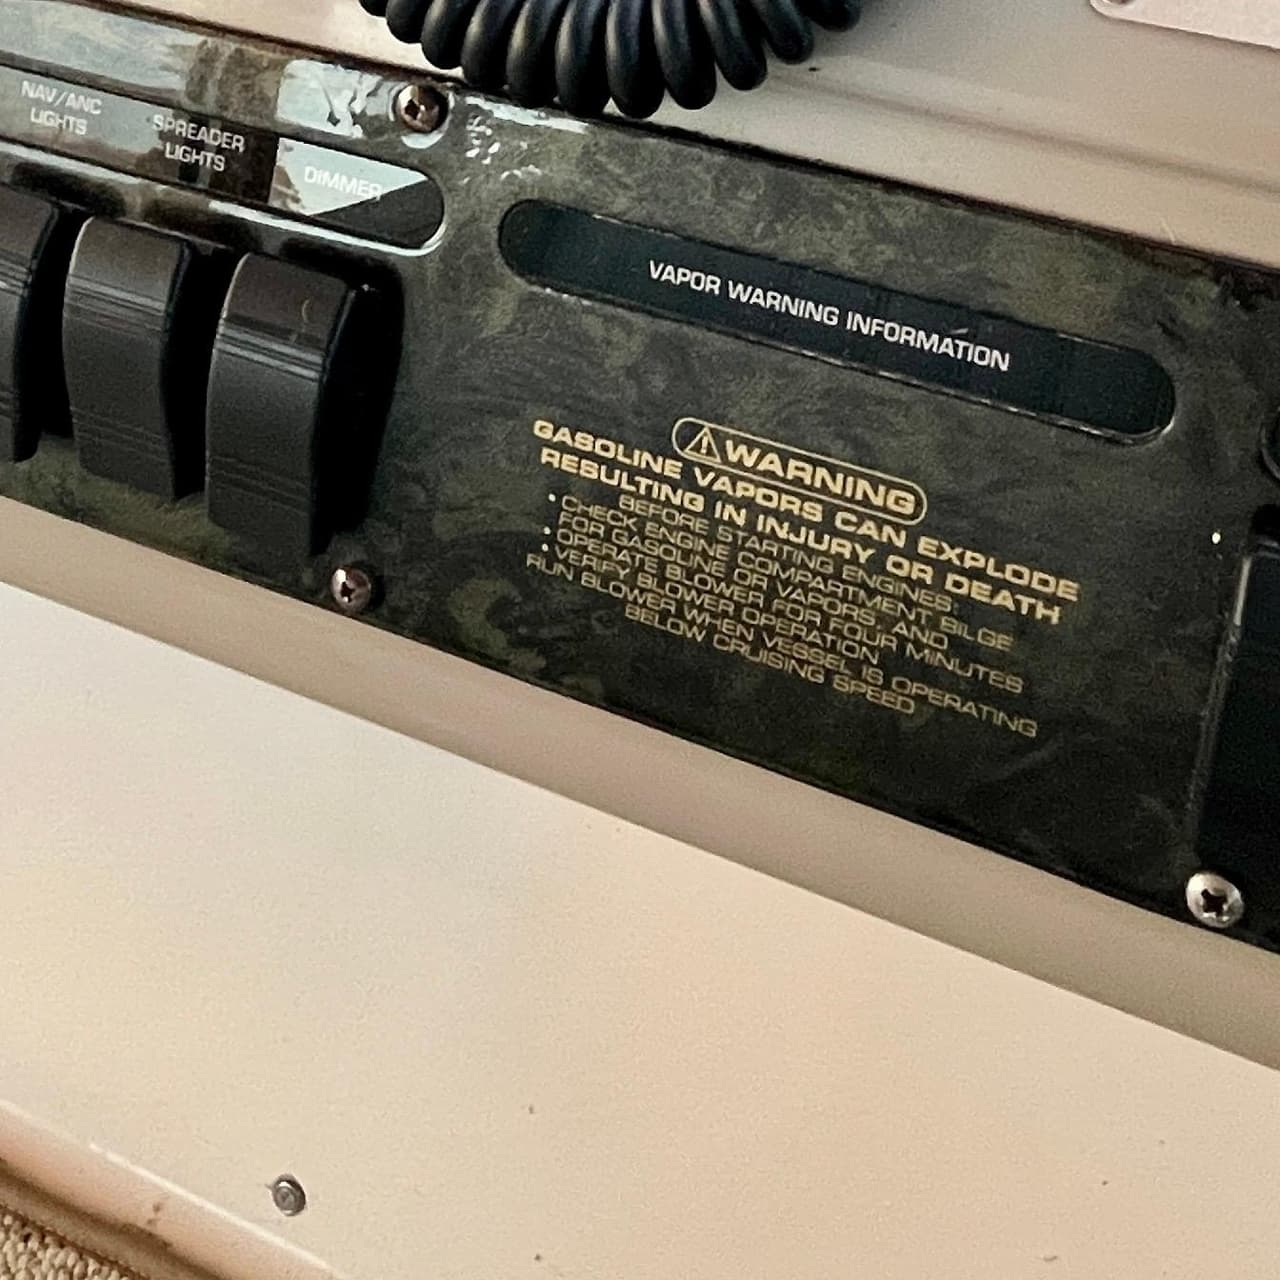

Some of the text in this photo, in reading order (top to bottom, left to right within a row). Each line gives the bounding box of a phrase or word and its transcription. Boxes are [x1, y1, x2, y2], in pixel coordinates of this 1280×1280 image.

[22, 79, 102, 115] NAV/ANC
[29, 106, 88, 135] LIGHTS
[152, 114, 245, 153] SPREADER
[164, 141, 224, 172] LIGHTS
[305, 165, 383, 199] DIMMER
[649, 260, 1009, 372] VAPOR WARNING INFORMATION
[533, 419, 1080, 602] GASOLINE VAPORS CAN EXPLODE
[725, 439, 916, 516] WARNING
[540, 447, 1060, 625] RESULTING IN INJURY OR DEATH
[559, 511, 605, 539] FOR
[612, 530, 727, 578] GASOLINE
[733, 568, 768, 591] OR
[891, 621, 949, 650] AND
[561, 494, 1015, 652] CHECK ENGINE COMPARTMENT BILGE
[619, 494, 710, 534] BEFORE
[717, 525, 833, 575] STARTING
[526, 553, 1038, 738] RUN BLOWER WHEN VESSEL IS OPERATING
[554, 545, 880, 665] VERIFY BLOWER OPERATION
[556, 528, 1024, 694] OPERATE BLOWER FOR FOUR MINUTES
[624, 604, 916, 715] BELOW CRUISING SPEED
